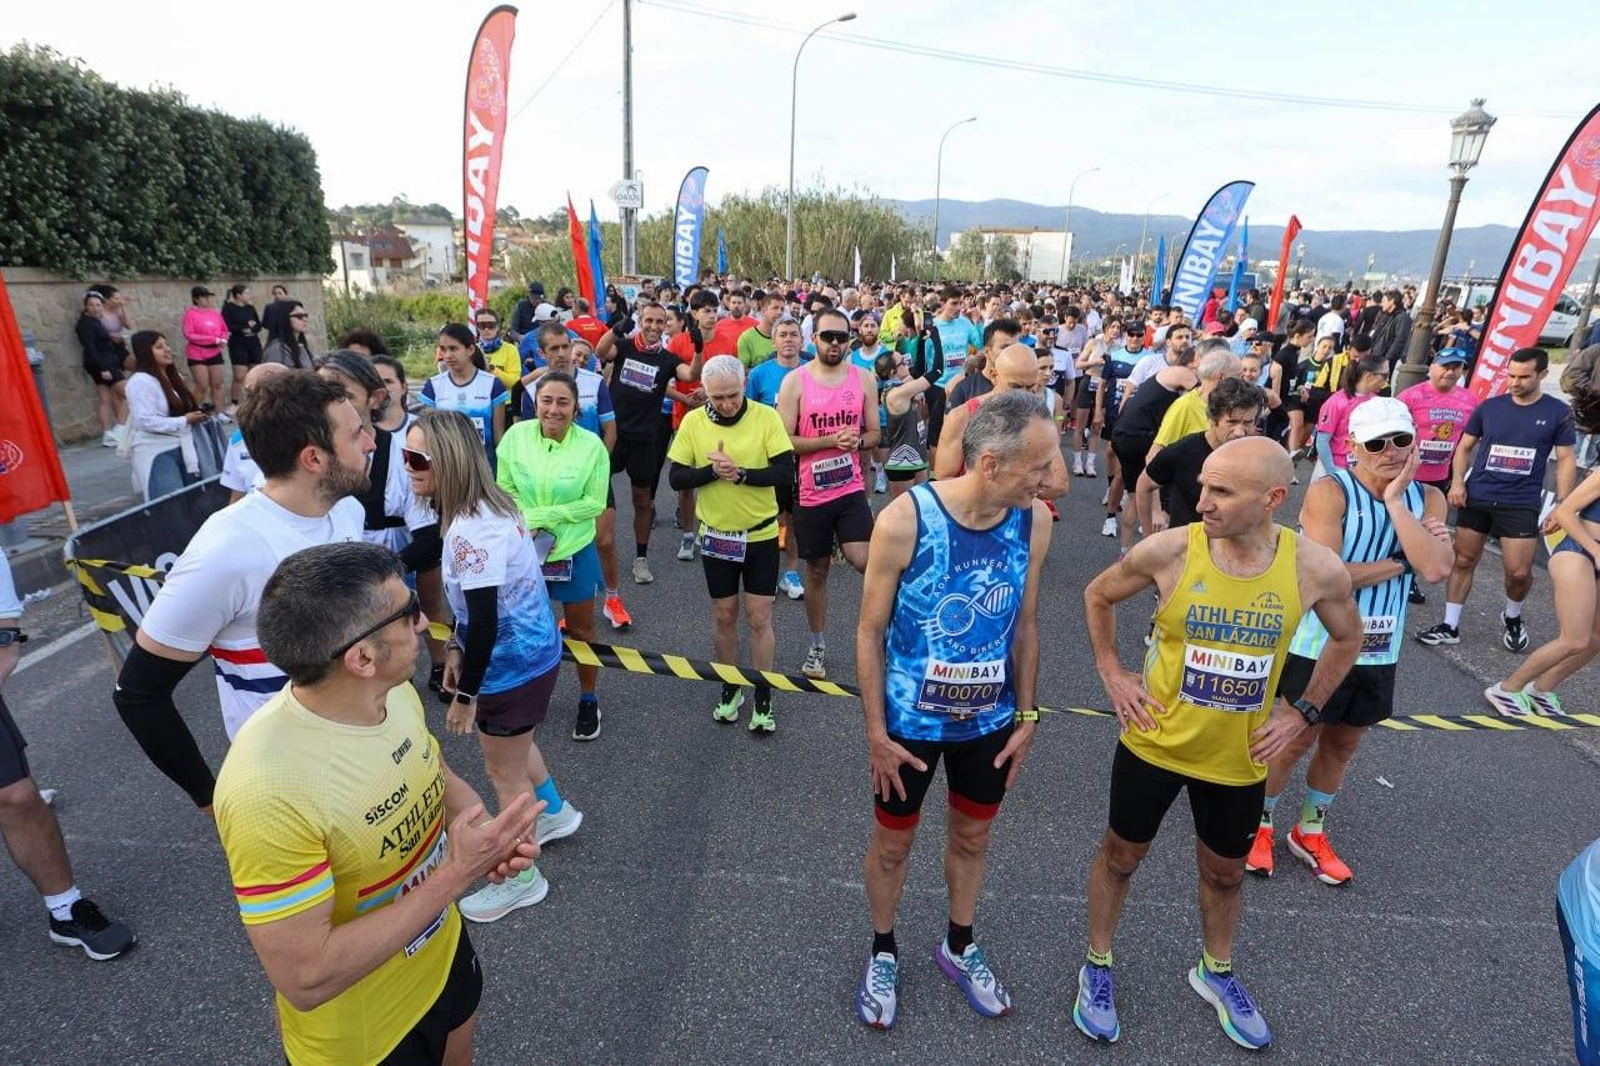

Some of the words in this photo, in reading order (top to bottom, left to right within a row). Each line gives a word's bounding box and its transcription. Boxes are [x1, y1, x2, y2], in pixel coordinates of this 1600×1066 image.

[810, 409, 858, 429] Triatlón
[953, 557, 1010, 573] RUNNERS
[1186, 604, 1284, 632] ATHLETICS
[945, 637, 966, 653] AND
[1186, 623, 1217, 641] SAN
[1220, 625, 1279, 649] LÁZARO
[932, 664, 1001, 680] MINIBAY
[1190, 649, 1269, 674] MINIBAY
[937, 683, 994, 701] 10070
[1196, 673, 1260, 697] 11650
[399, 830, 421, 861] San
